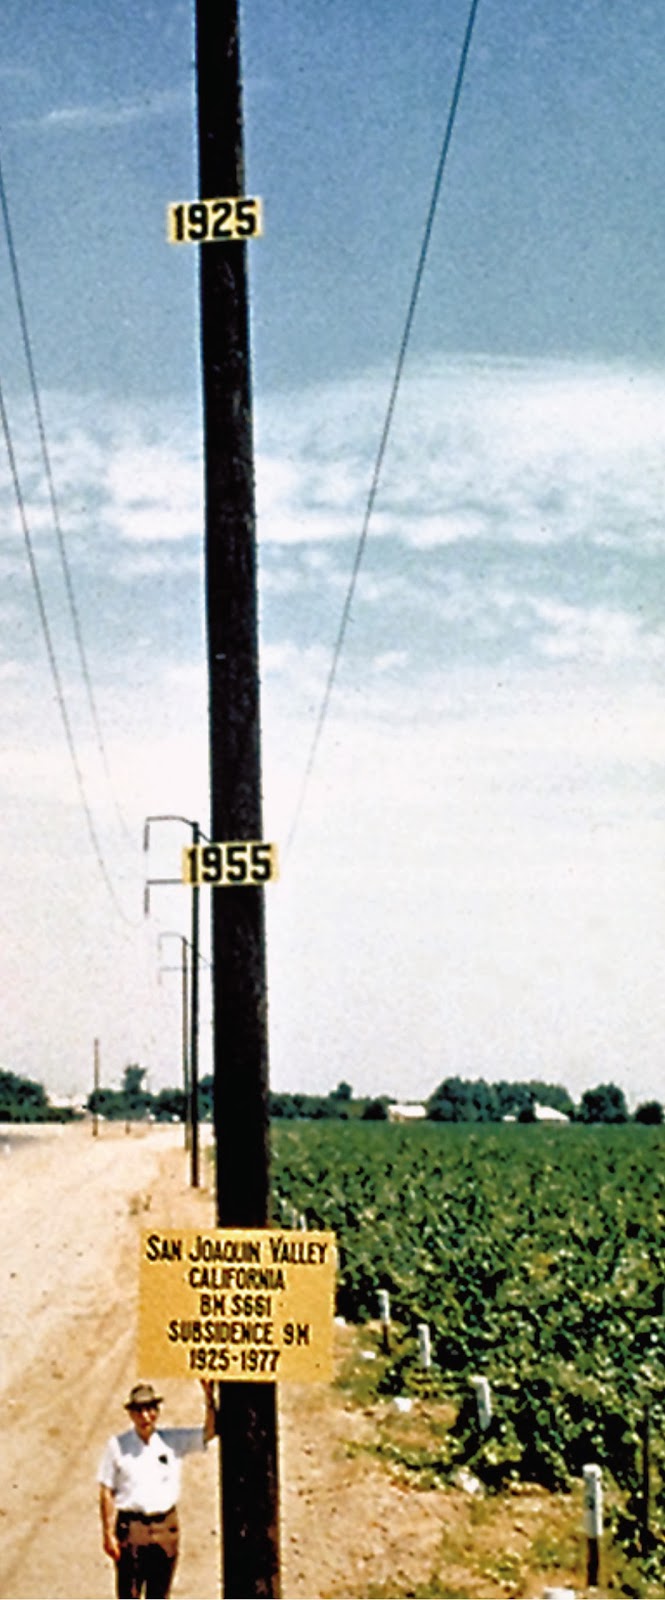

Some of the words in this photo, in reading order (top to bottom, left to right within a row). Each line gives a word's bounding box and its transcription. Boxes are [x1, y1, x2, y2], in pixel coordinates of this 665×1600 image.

[174, 200, 256, 240] 1925
[188, 844, 271, 883] 1955
[147, 1234, 182, 1261] SAN
[189, 1235, 261, 1263] JOAQUIN
[270, 1236, 327, 1264] VALLEY
[188, 1267, 285, 1290] CALIFORNIA
[200, 1294, 225, 1316] BM
[231, 1294, 271, 1317] S661
[168, 1320, 273, 1345] SUBSIDENCE
[283, 1322, 309, 1345] 9M
[189, 1348, 280, 1371] 1925-1977
